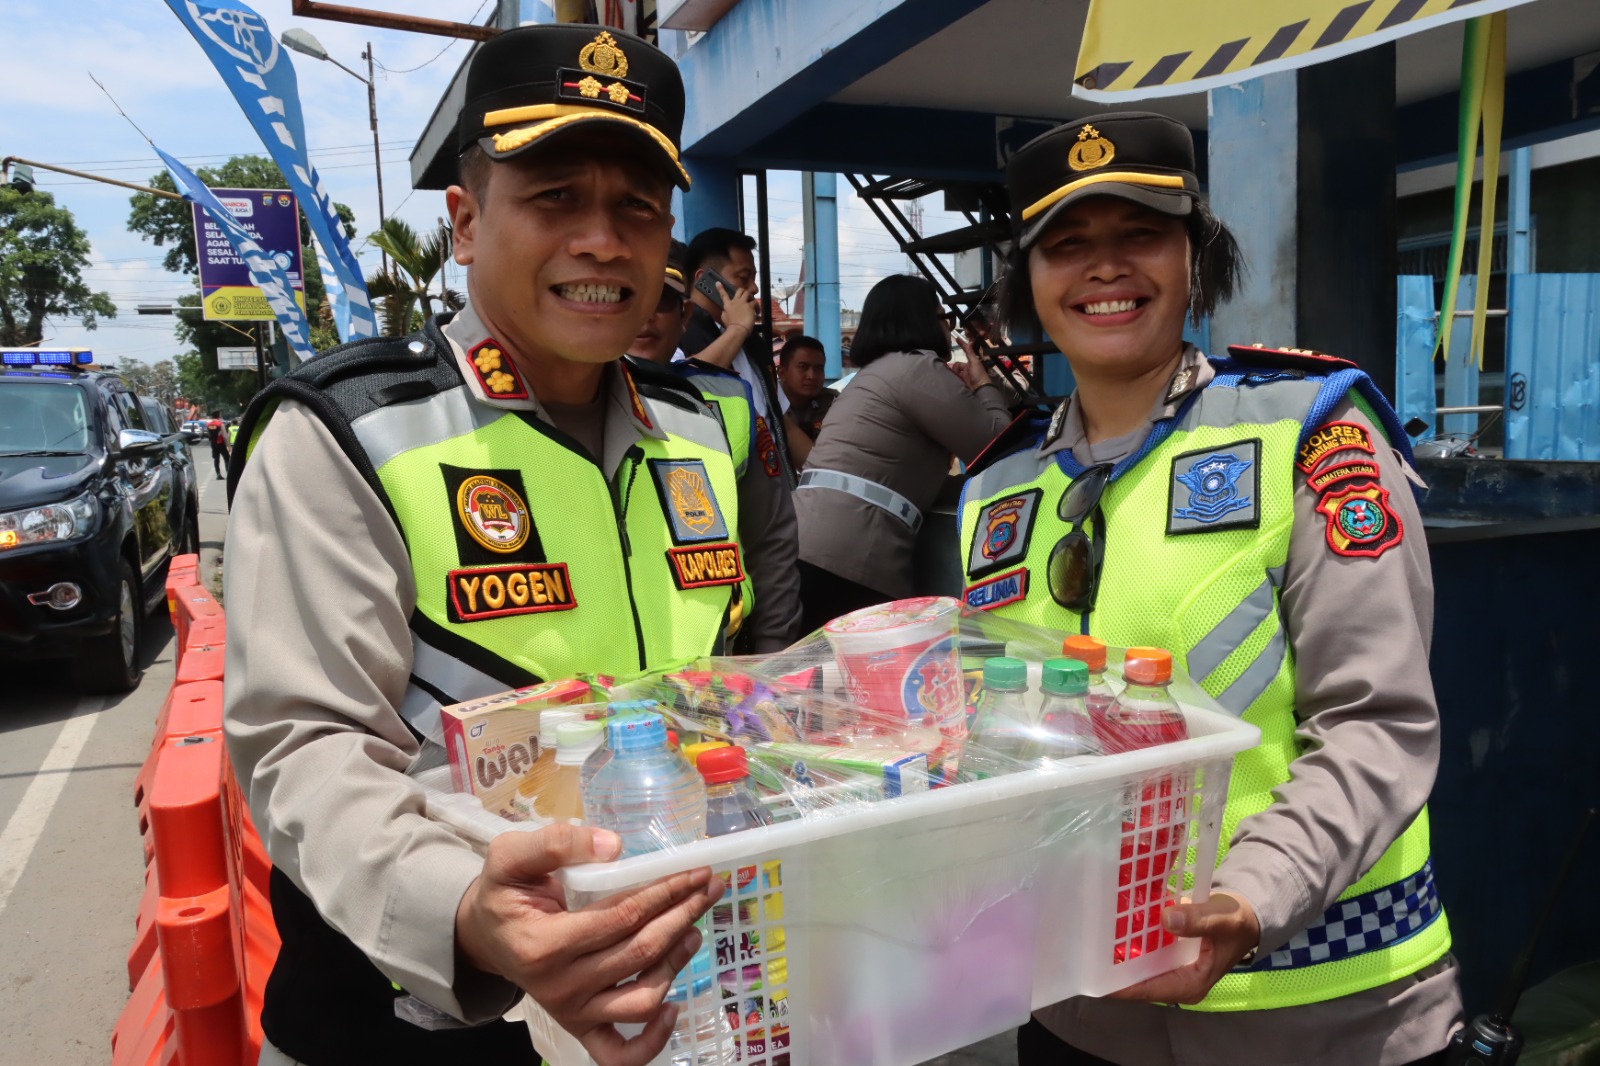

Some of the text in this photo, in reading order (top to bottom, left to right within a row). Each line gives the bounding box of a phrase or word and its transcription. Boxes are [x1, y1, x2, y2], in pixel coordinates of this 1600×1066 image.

[207, 239, 230, 248] AGAR
[208, 257, 245, 265] SAAT TU
[1300, 425, 1363, 457] POLRES
[1303, 438, 1339, 468] PEMATANG
[1315, 466, 1375, 486] SUMATERA UTARA
[684, 509, 706, 518] POLRI
[676, 549, 737, 582] KAPOLRES
[460, 569, 565, 613] YOGEN
[481, 743, 506, 755] Tango
